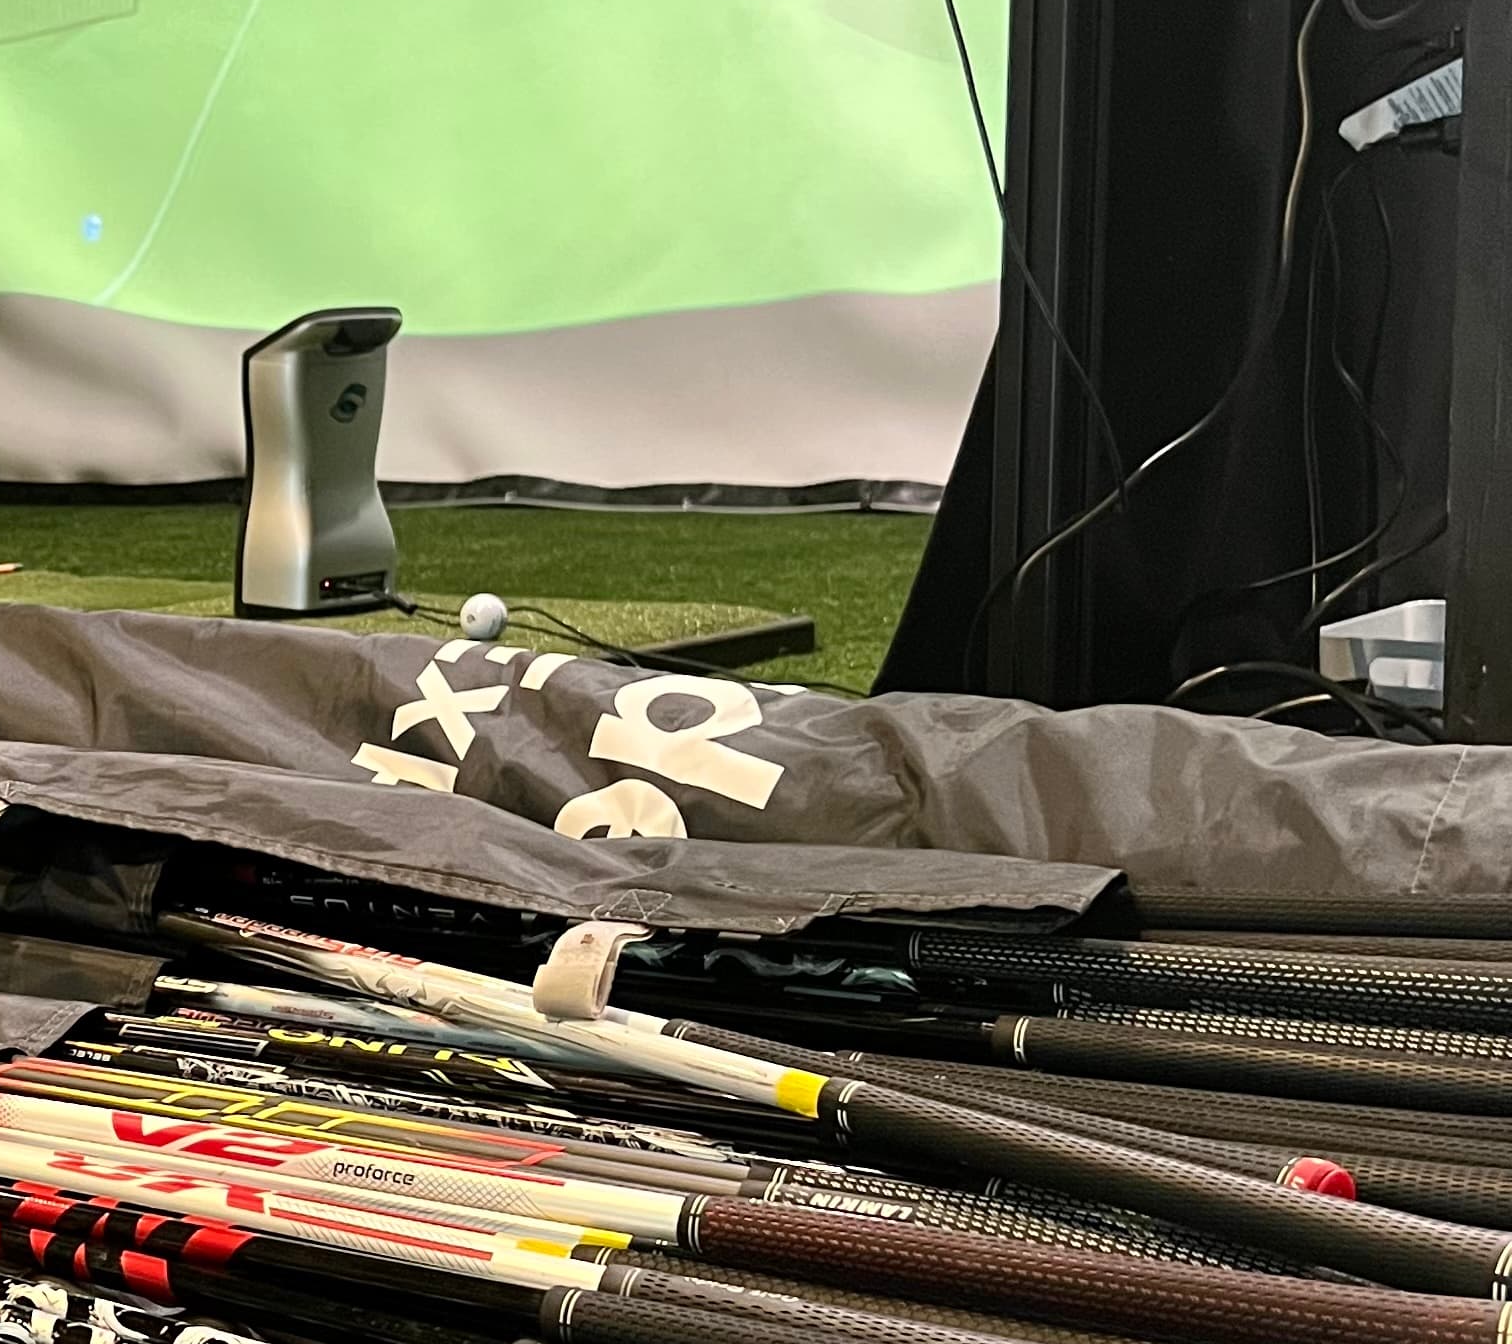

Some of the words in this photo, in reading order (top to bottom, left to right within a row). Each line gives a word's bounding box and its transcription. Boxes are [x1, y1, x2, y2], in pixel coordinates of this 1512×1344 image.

[111, 1110, 335, 1167] V2
[332, 1158, 416, 1187] proforce
[808, 1191, 913, 1221] LAMKIN
